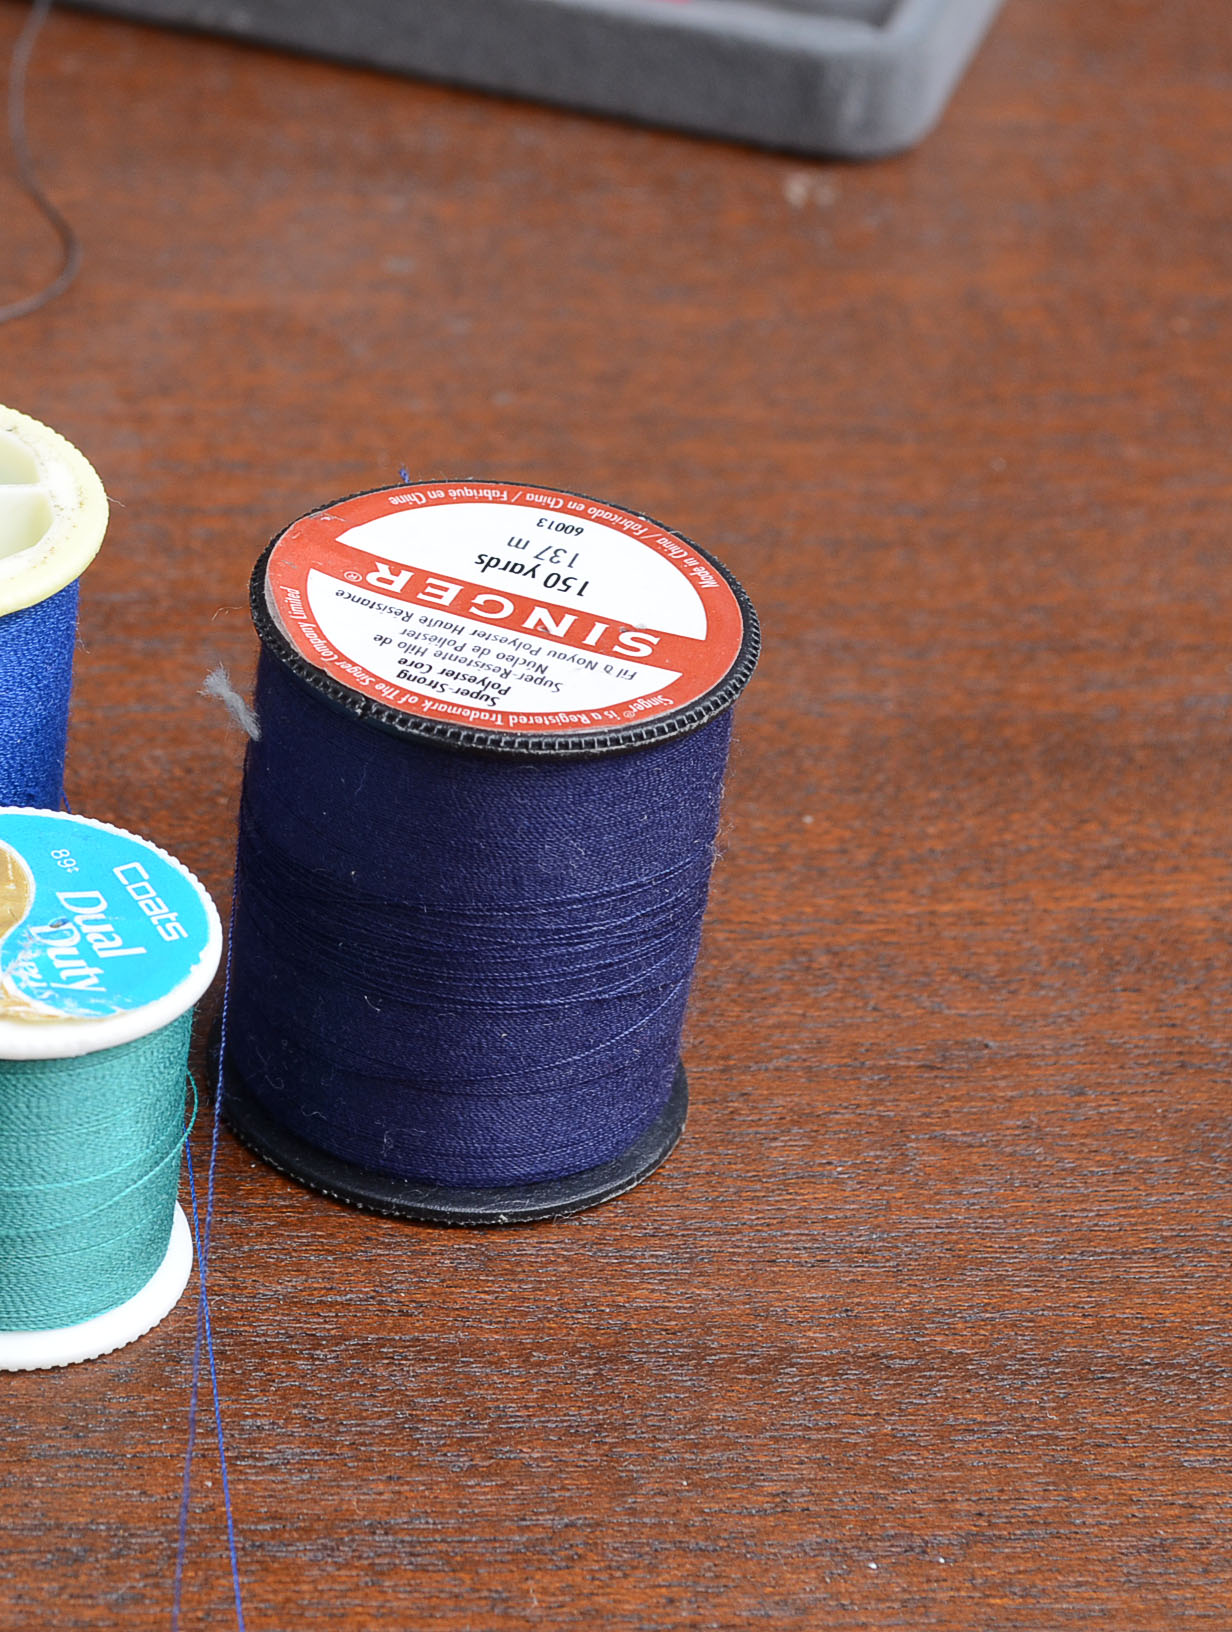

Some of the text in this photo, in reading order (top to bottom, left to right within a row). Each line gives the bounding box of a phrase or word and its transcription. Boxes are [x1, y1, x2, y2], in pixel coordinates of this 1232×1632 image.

[388, 487, 719, 589] Made in China / Fabricado en China / Fabriqué en Chine
[536, 517, 584, 537] 60013
[506, 536, 580, 569] 137 m
[474, 554, 590, 597] 150 yards
[279, 586, 308, 621] Limited
[335, 589, 415, 623] Résistance
[419, 615, 465, 635] Haute
[298, 621, 339, 664] Company
[400, 628, 549, 675] Núcleo de Poliéster
[468, 628, 542, 656] Polyester
[337, 661, 376, 686] Singer
[373, 634, 564, 693] Super-Resistente Hilo de
[397, 657, 512, 696] Polyester Core
[546, 650, 599, 671] Noyau
[617, 668, 638, 681] Fil
[375, 681, 400, 701] The
[396, 669, 500, 708] Super-Strong
[398, 691, 419, 704] of
[421, 698, 504, 726] Trademark
[509, 712, 590, 727] Registered
[590, 712, 602, 721] a
[607, 711, 620, 720] is
[113, 862, 189, 942] Coats
[55, 890, 147, 958] Dual
[29, 921, 107, 991] Duty
